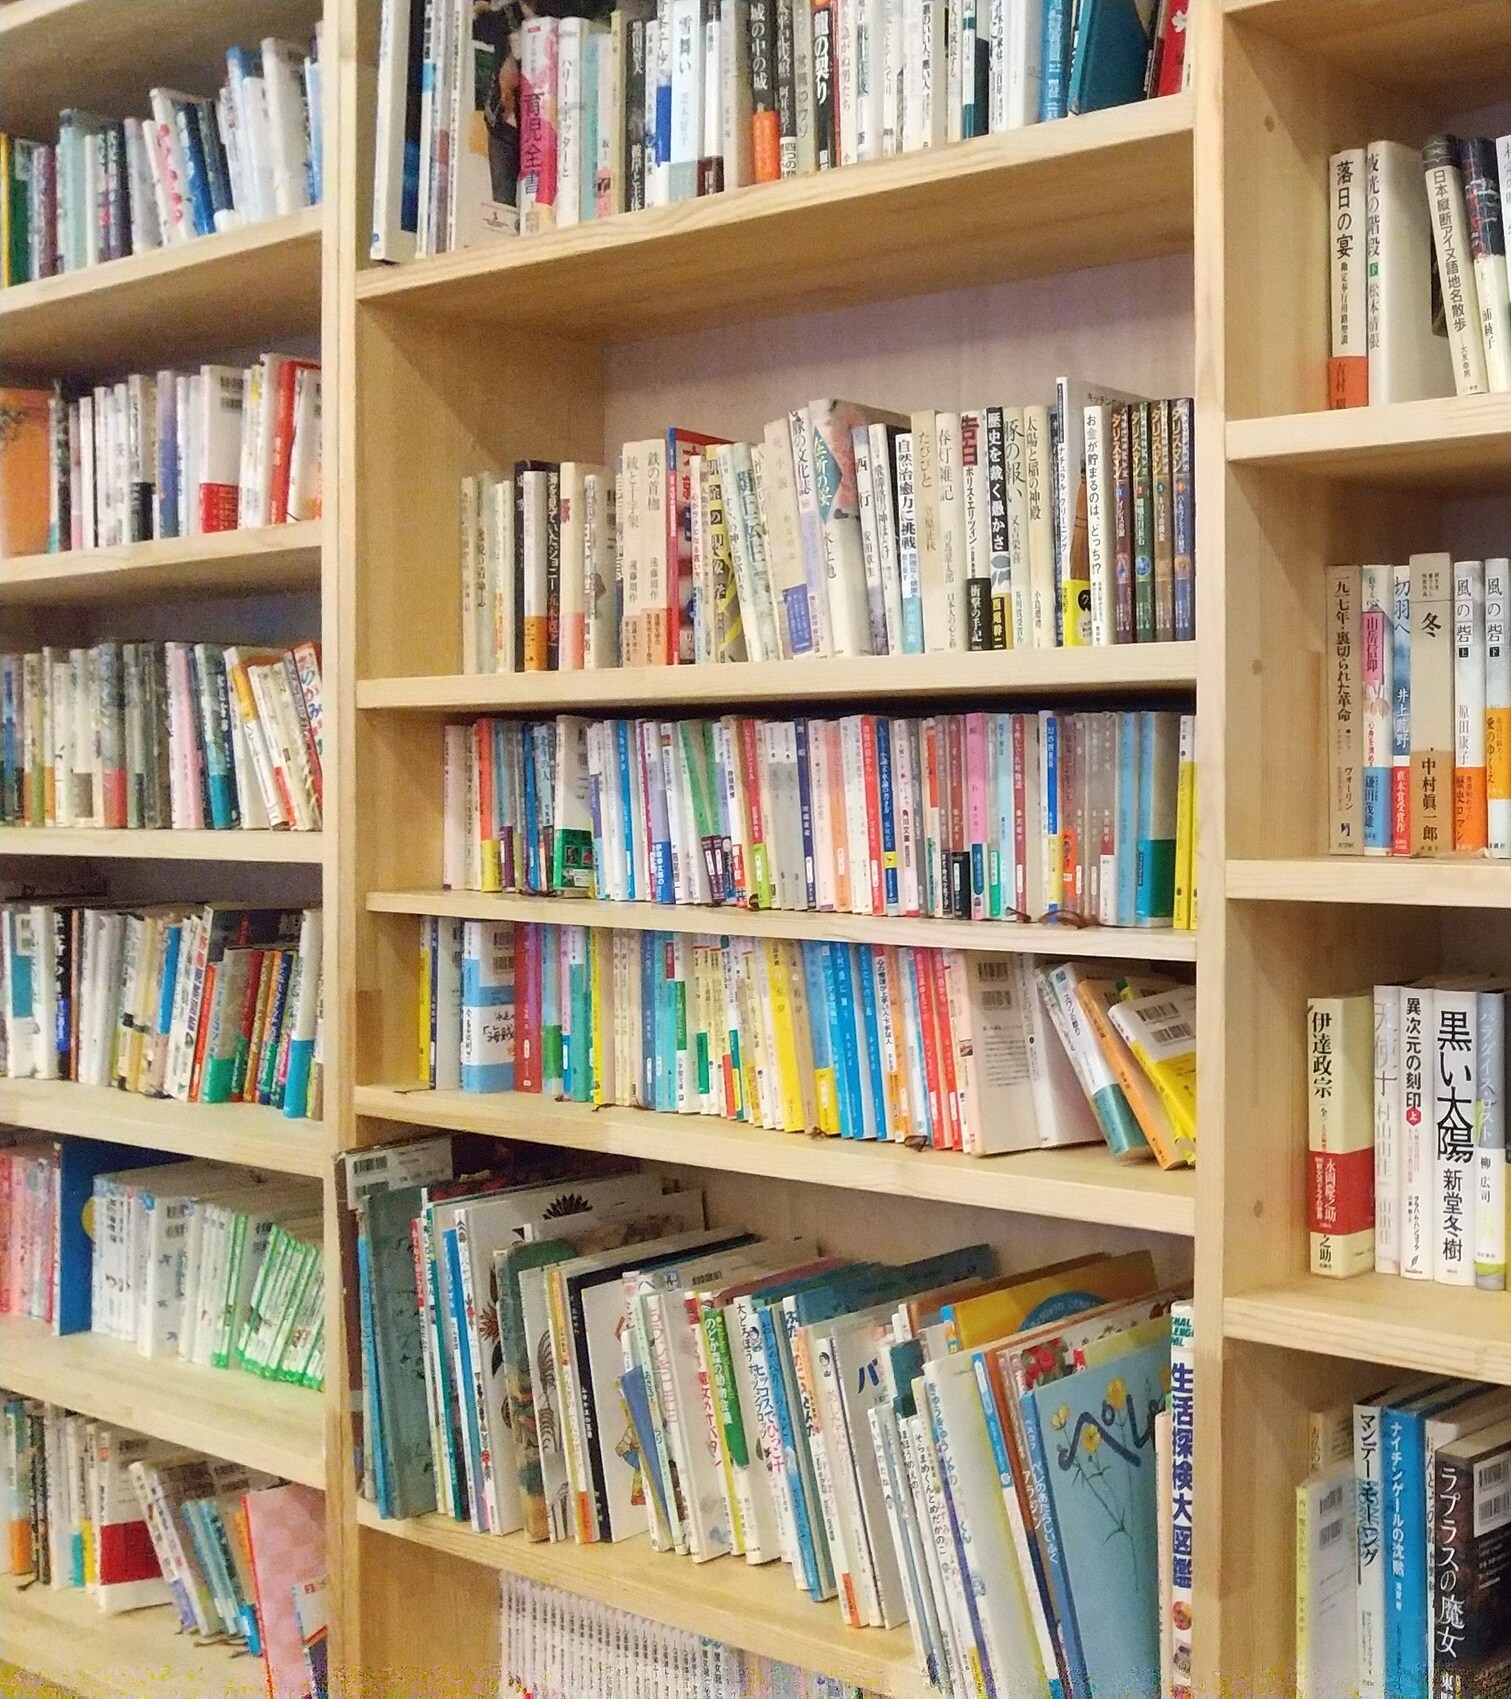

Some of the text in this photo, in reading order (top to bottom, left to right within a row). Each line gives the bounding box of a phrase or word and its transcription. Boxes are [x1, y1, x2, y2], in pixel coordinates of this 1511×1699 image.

[1336, 161, 1353, 259] 落日の宴
[1006, 421, 1026, 502] 豚の報い
[971, 585, 982, 642] 衝撃の手記
[1457, 577, 1473, 643] 風の砦
[1488, 577, 1503, 643] 風の砦
[1396, 689, 1410, 748] 井上荒野
[1459, 705, 1469, 764] 原田康子
[1311, 1011, 1332, 1098] 伊達政宗
[1406, 998, 1422, 1108] 異次元の刻印
[1437, 1011, 1473, 1163] 黒い太陽
[1442, 1169, 1462, 1262] 新堂冬樹
[1480, 1157, 1491, 1202] 柳広司
[916, 1435, 947, 1554] そらまめくんとめだかのこ
[1171, 1363, 1193, 1588] 生活探検大図鑑
[1438, 1467, 1466, 1658] ラプラスの魔女
